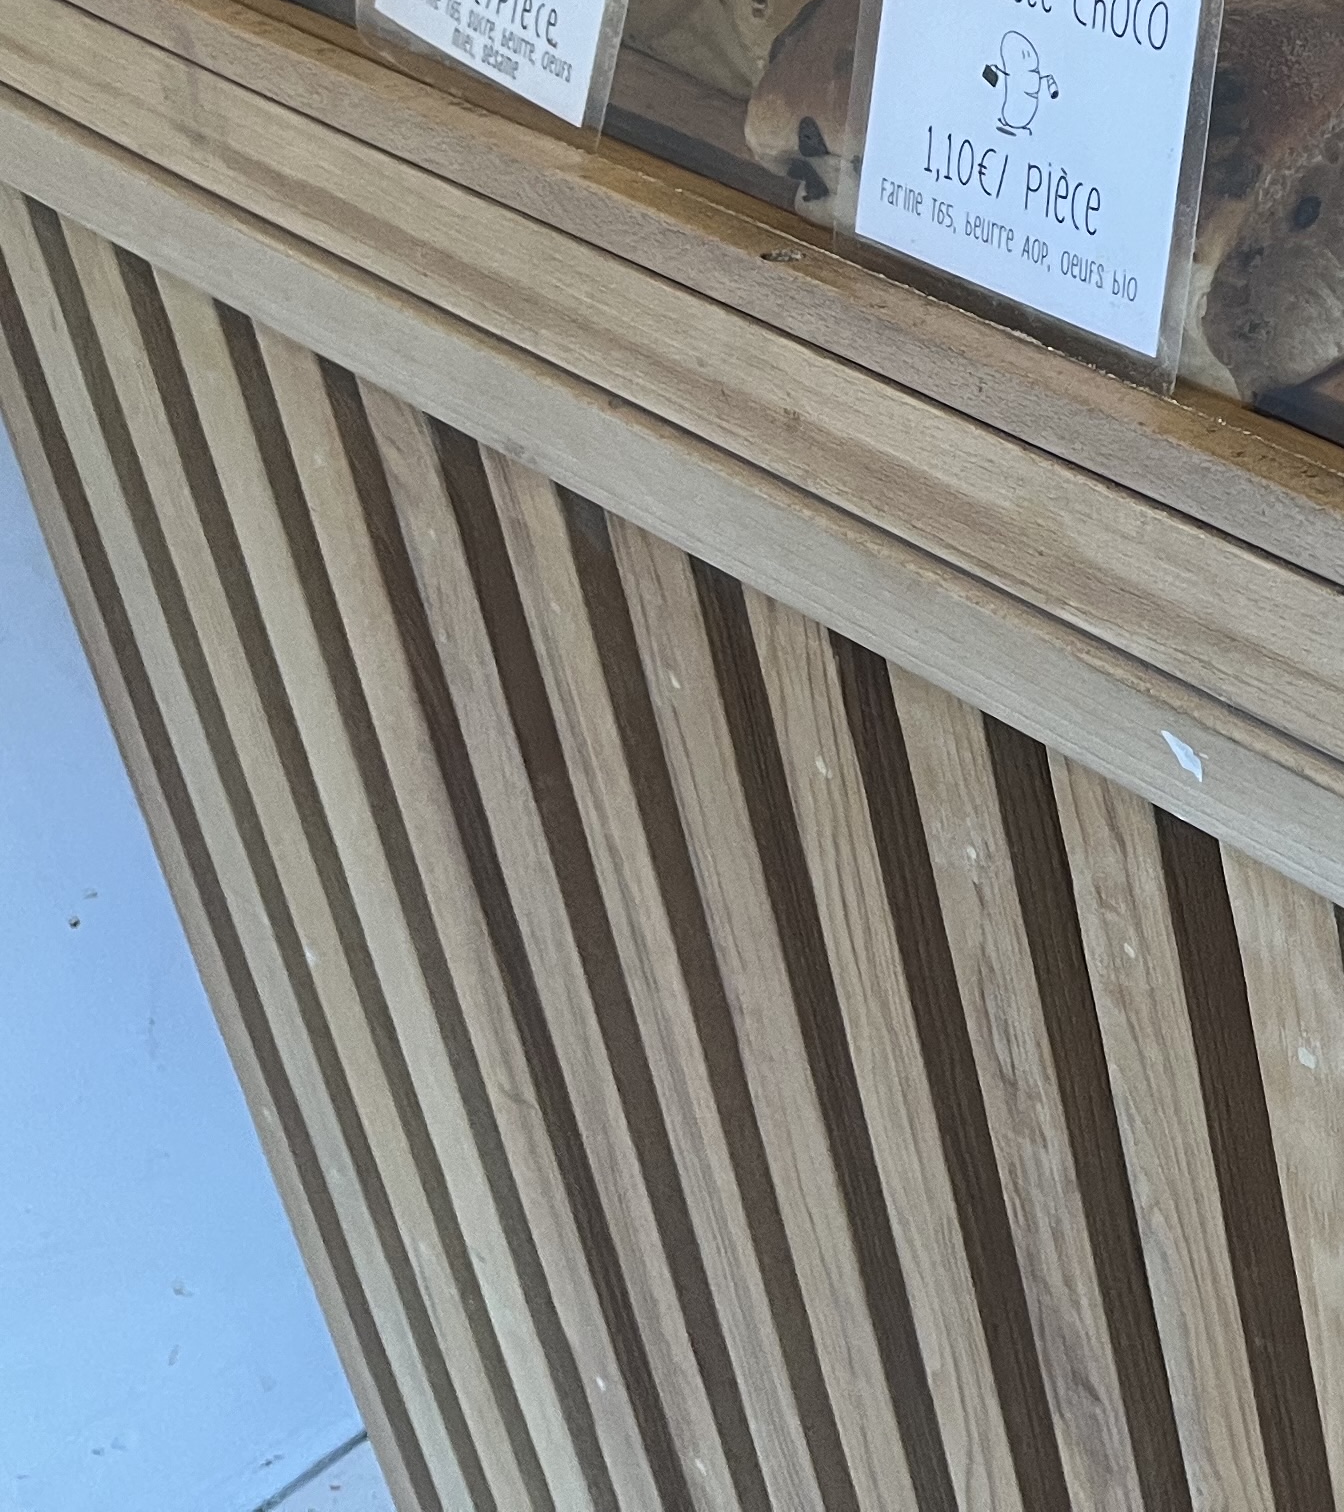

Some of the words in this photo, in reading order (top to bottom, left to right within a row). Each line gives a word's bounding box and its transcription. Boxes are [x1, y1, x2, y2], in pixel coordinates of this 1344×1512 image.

[879, 177, 924, 218] Farine
[930, 197, 957, 234] T65,
[965, 211, 1015, 253] beurre
[1021, 235, 1051, 273] AOP,
